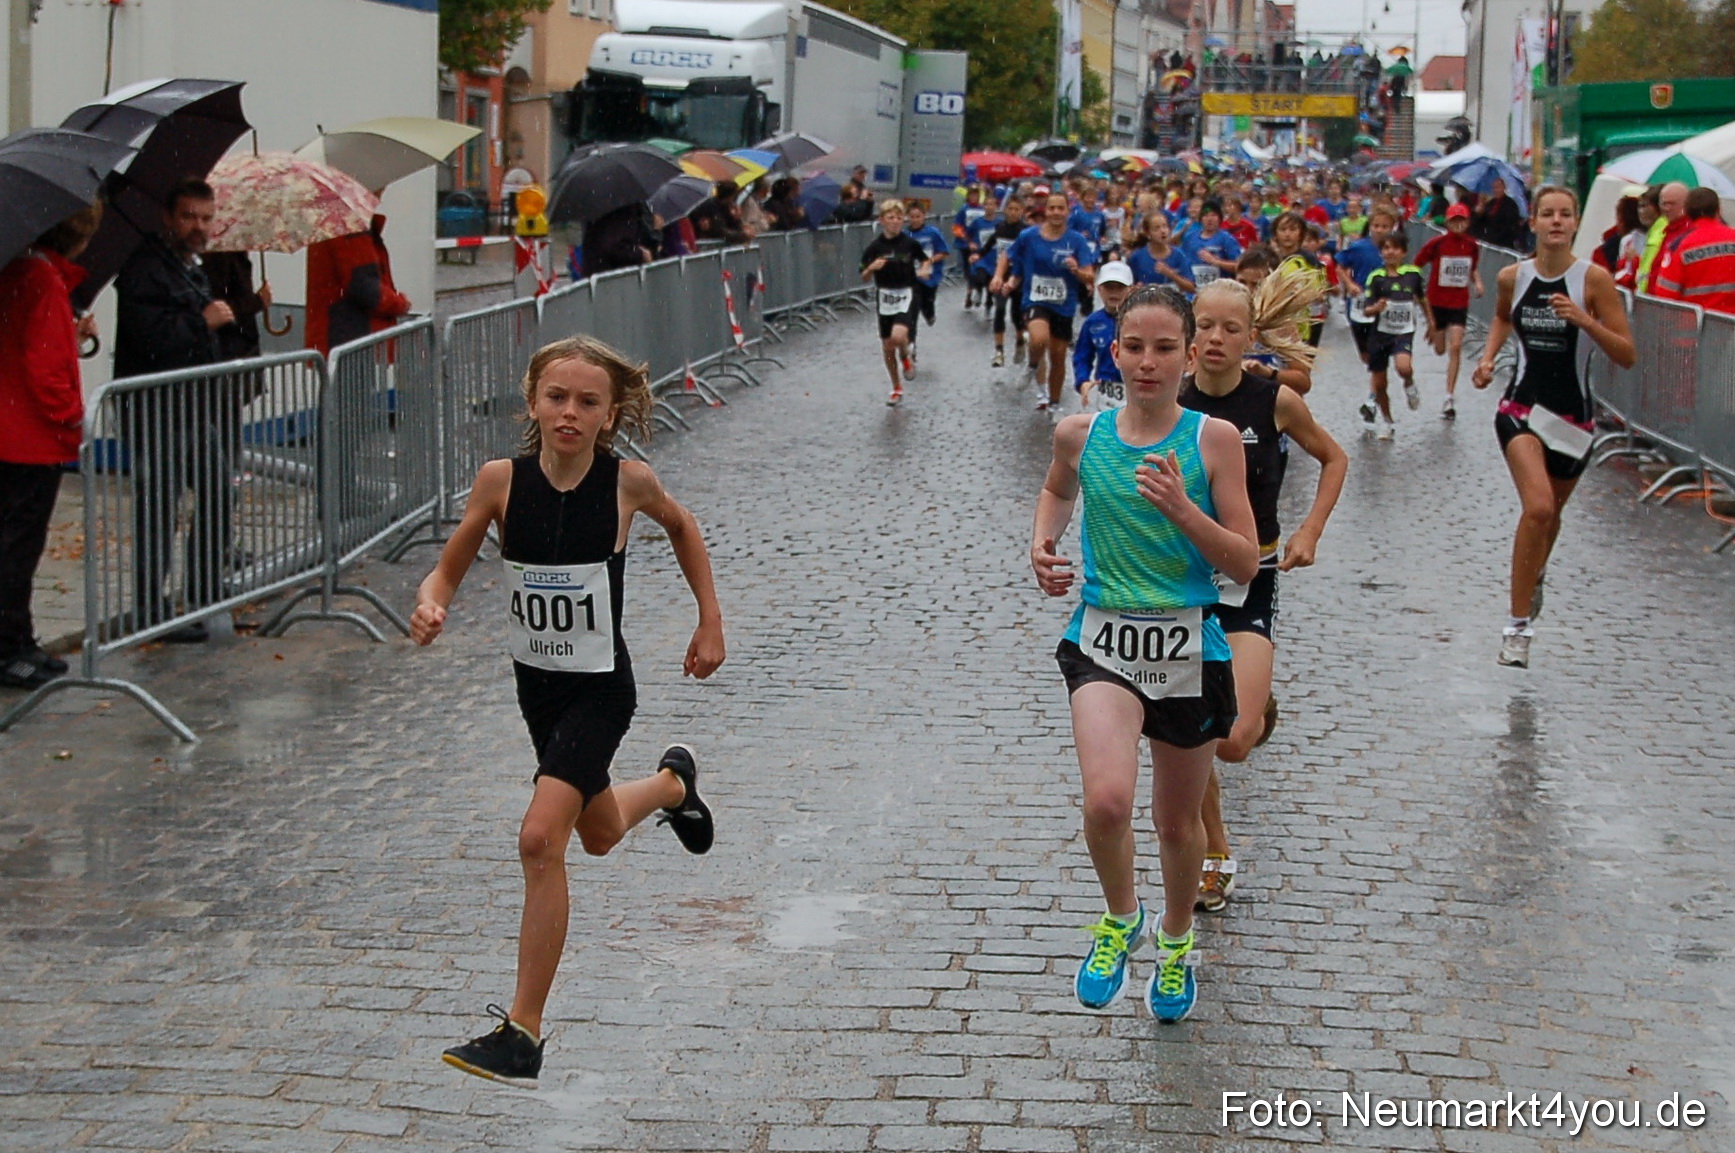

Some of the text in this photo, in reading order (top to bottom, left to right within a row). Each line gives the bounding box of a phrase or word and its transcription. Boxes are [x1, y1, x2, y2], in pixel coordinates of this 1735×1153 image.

[631, 49, 713, 69] BOCK
[914, 90, 965, 115] BO
[1251, 98, 1304, 112] START
[1033, 284, 1064, 300] 4075
[523, 571, 572, 583] BOCK
[511, 590, 595, 632] 4001
[529, 638, 574, 656] Ulrich
[1092, 621, 1190, 662] 4002
